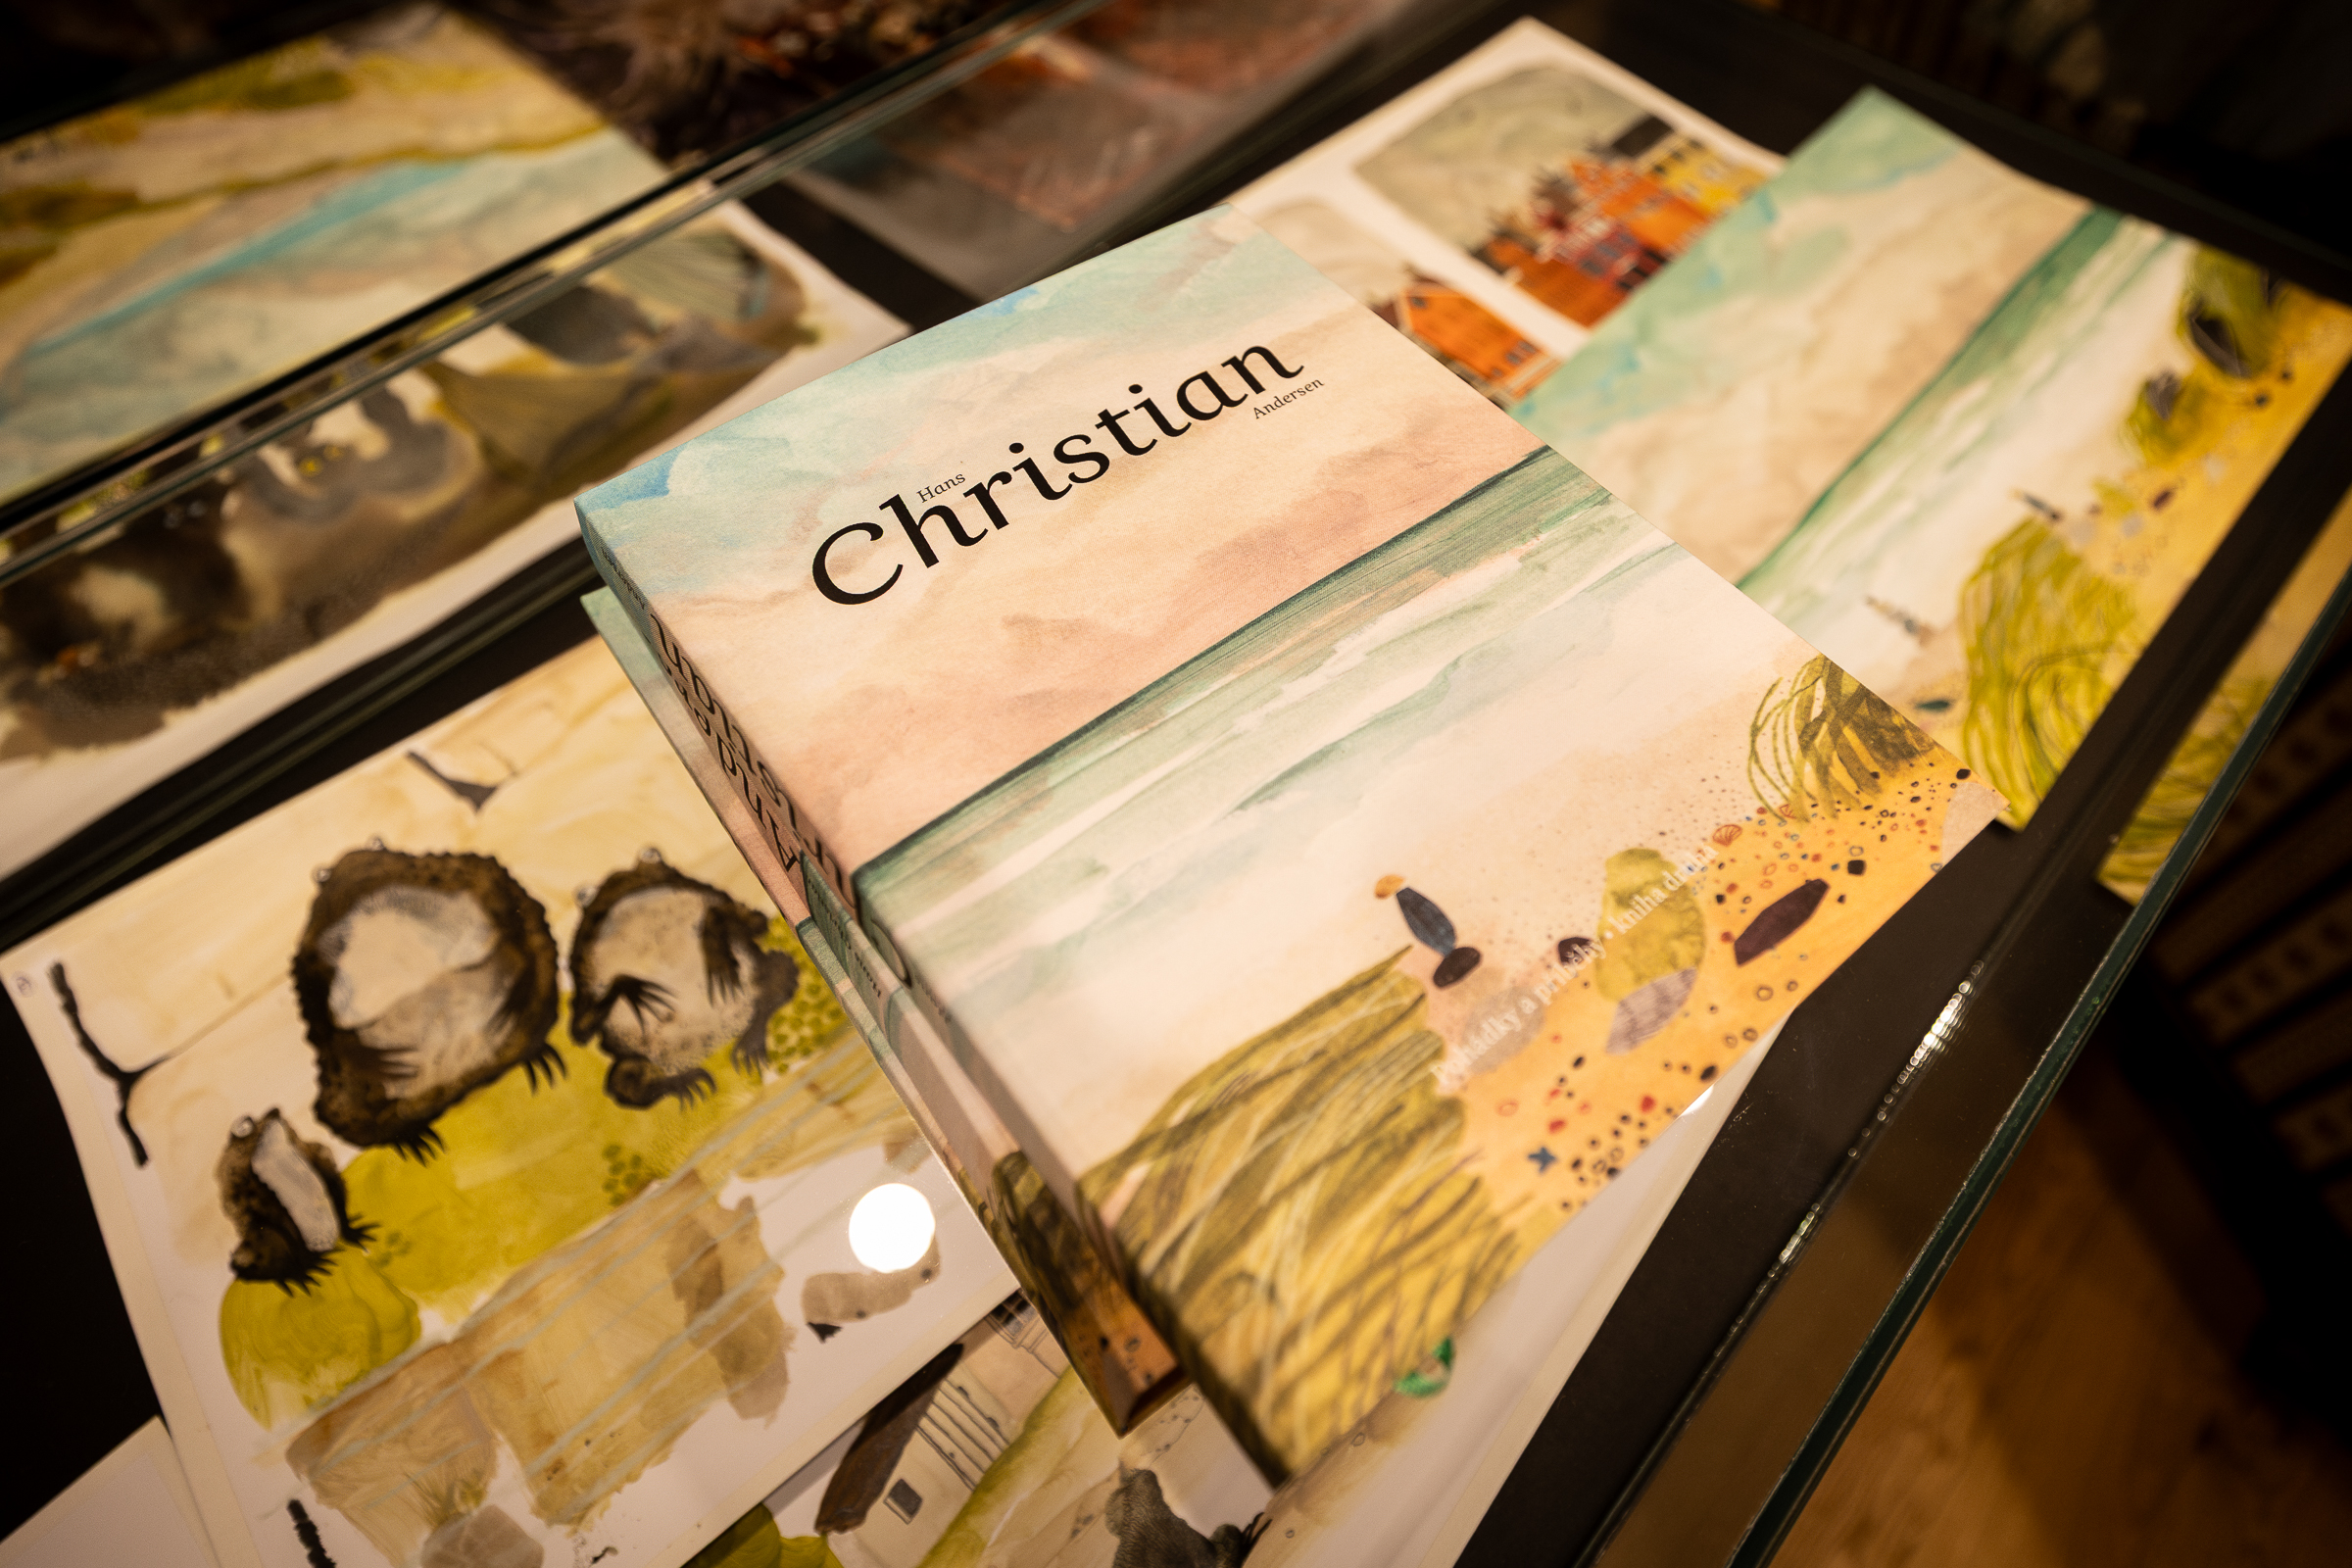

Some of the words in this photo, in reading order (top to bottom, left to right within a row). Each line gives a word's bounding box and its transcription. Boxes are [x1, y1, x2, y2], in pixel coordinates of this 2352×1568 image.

[1252, 377, 1325, 420] Andersen
[811, 345, 1304, 606] Christian
[917, 474, 966, 503] Hans
[1518, 996, 1539, 1016] a
[1608, 887, 1668, 934] kniha
